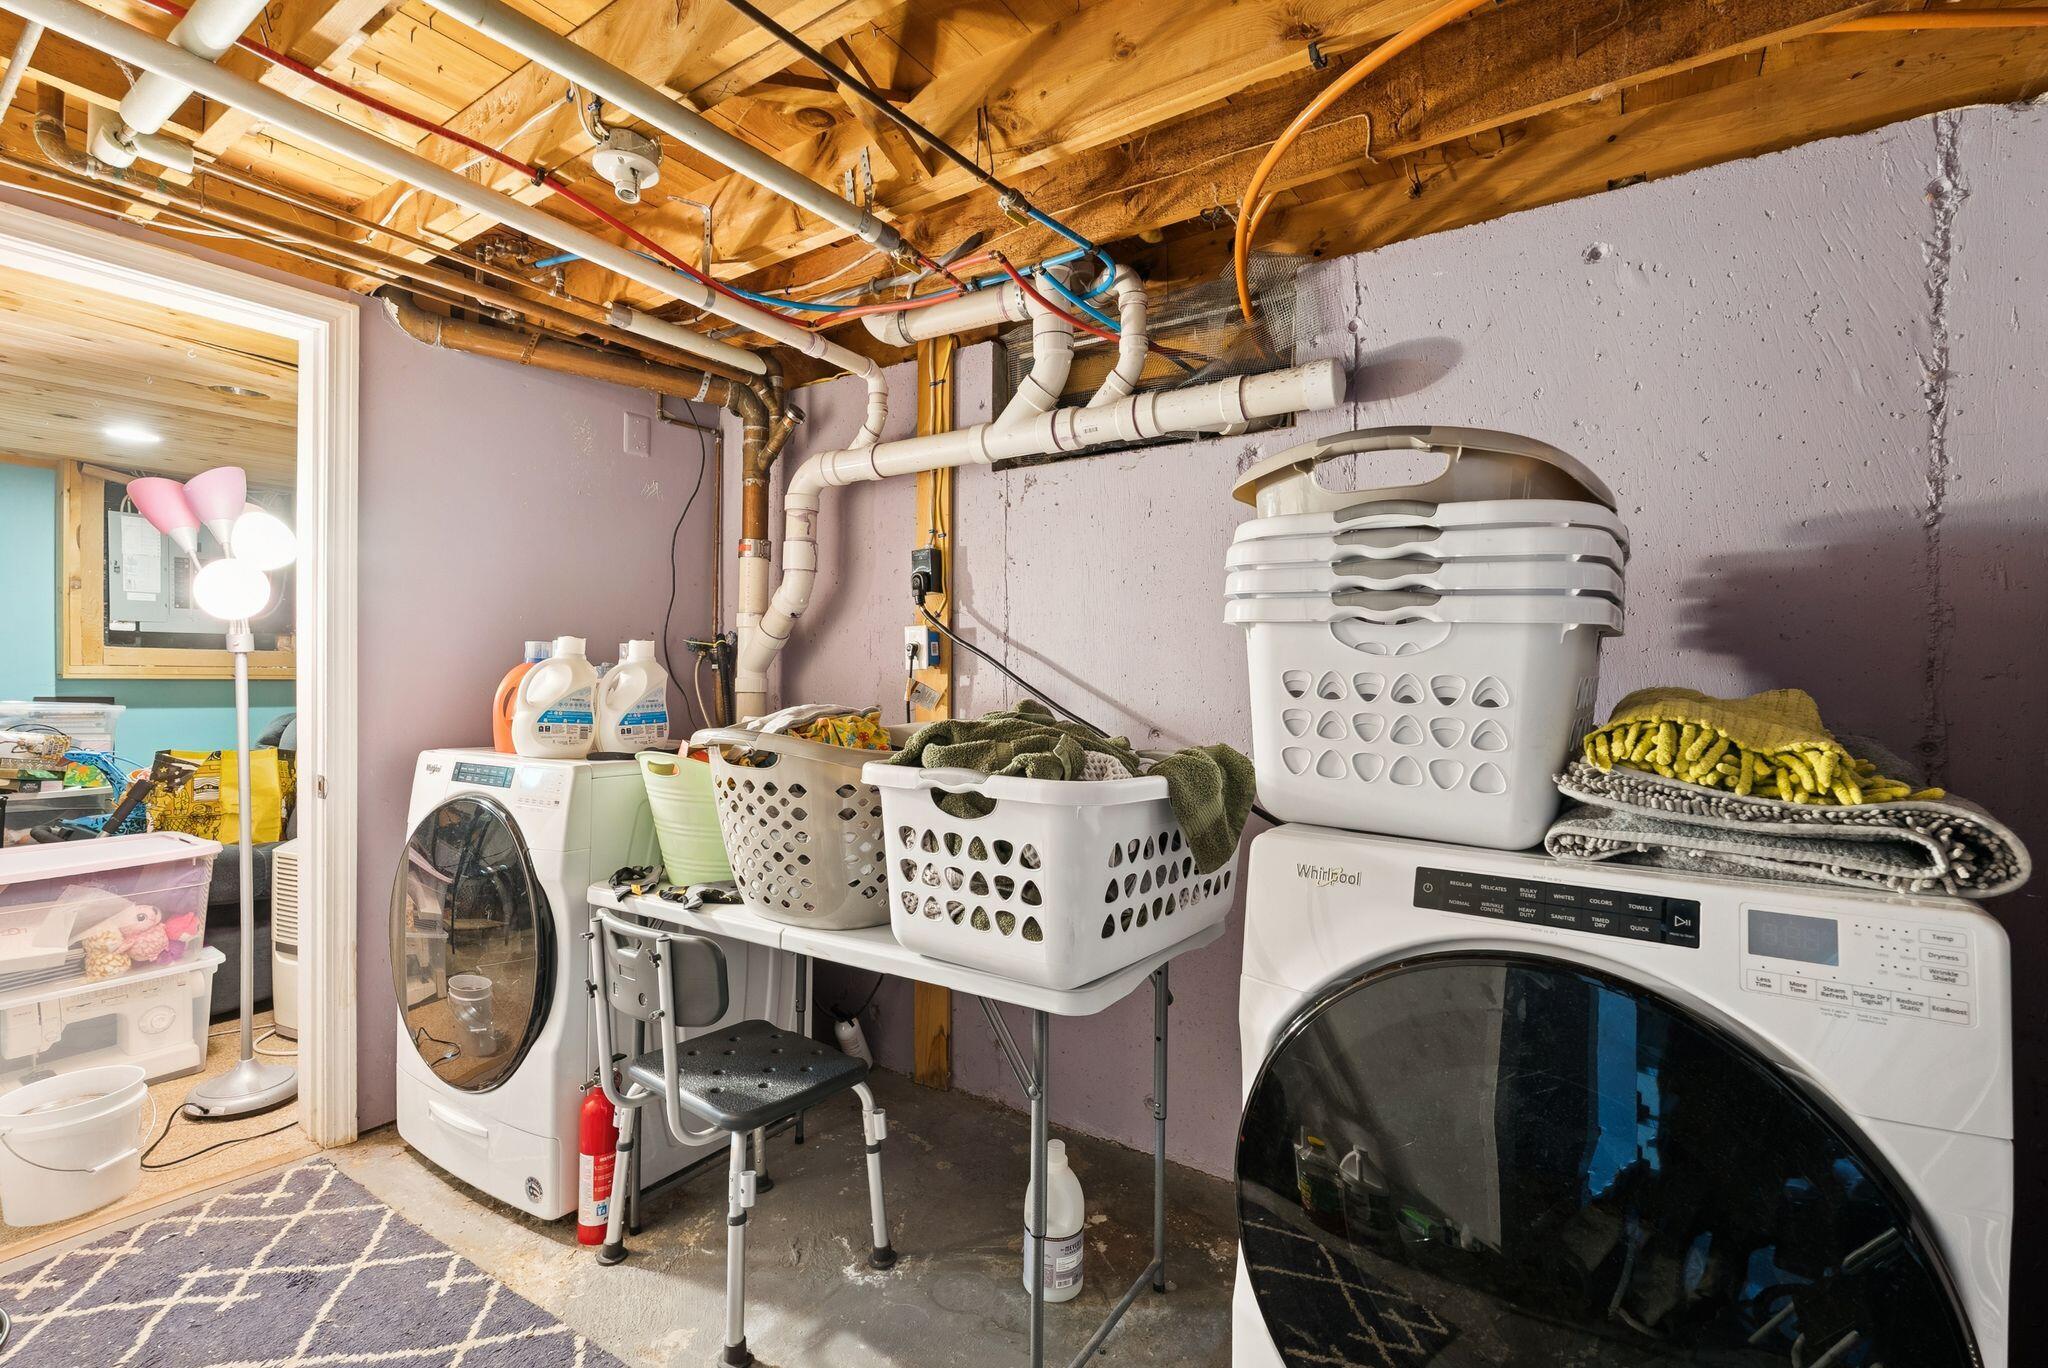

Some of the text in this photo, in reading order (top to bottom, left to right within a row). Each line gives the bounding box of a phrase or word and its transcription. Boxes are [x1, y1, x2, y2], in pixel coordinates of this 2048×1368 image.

[1296, 863, 1362, 886] Whirlpool
[1449, 880, 1473, 888] REGULAR
[1480, 884, 1507, 893] DELICATES
[1553, 893, 1575, 901] WHITES
[1448, 899, 1471, 907] NORMAL
[1589, 898, 1613, 906] COLORS
[1480, 906, 1505, 914] CONTROL
[1628, 903, 1653, 912] TOWELS
[1550, 913, 1576, 922] SANITIZE
[1630, 924, 1650, 932] QUICK
[1932, 934, 1954, 942] Temp
[1790, 986, 1807, 994] Time
[1877, 993, 1891, 1002] Dry
